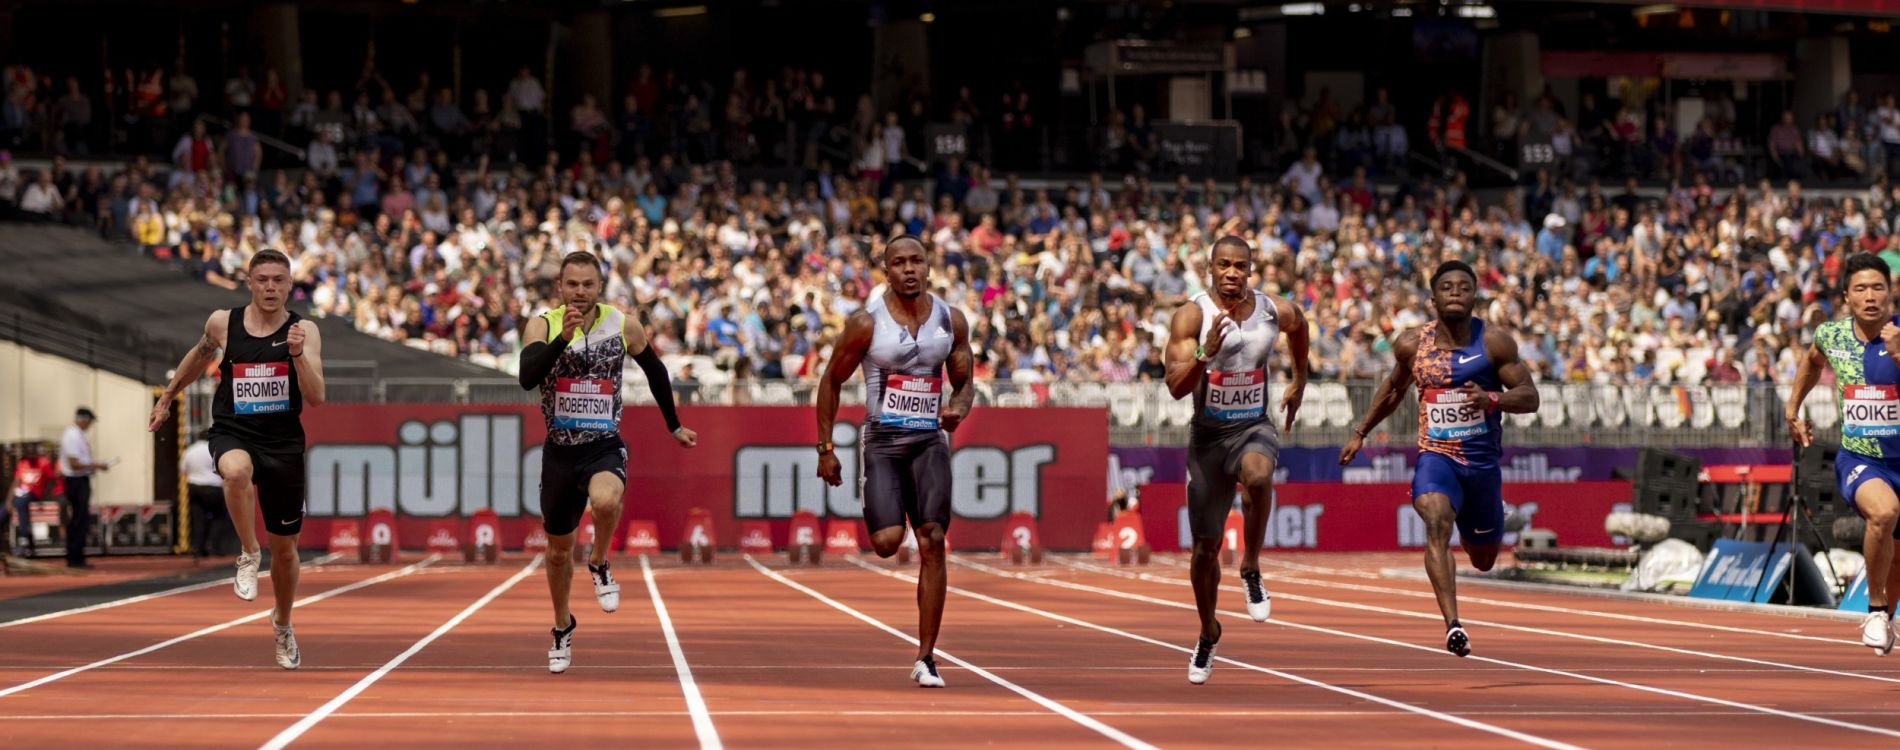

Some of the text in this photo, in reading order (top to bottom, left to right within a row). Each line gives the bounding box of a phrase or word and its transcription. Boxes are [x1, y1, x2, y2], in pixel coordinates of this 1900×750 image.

[245, 363, 276, 377] müller
[570, 379, 602, 393] müller
[901, 377, 933, 392] müller
[1222, 372, 1255, 386] müller
[236, 380, 286, 398] BROMBY
[1210, 387, 1261, 405] BLAKE
[1854, 385, 1887, 400] müller
[253, 403, 286, 412] London
[558, 396, 610, 414] ROBERTSON
[887, 392, 937, 414] SIMBINE
[1226, 411, 1260, 419] London
[1846, 404, 1898, 421] KOIKE
[575, 420, 608, 429] London
[902, 418, 933, 428] London
[1448, 427, 1482, 438] London
[1862, 427, 1897, 436] London
[306, 413, 544, 517] müll
[1118, 526, 1138, 549] 2
[1226, 528, 1238, 549] 1
